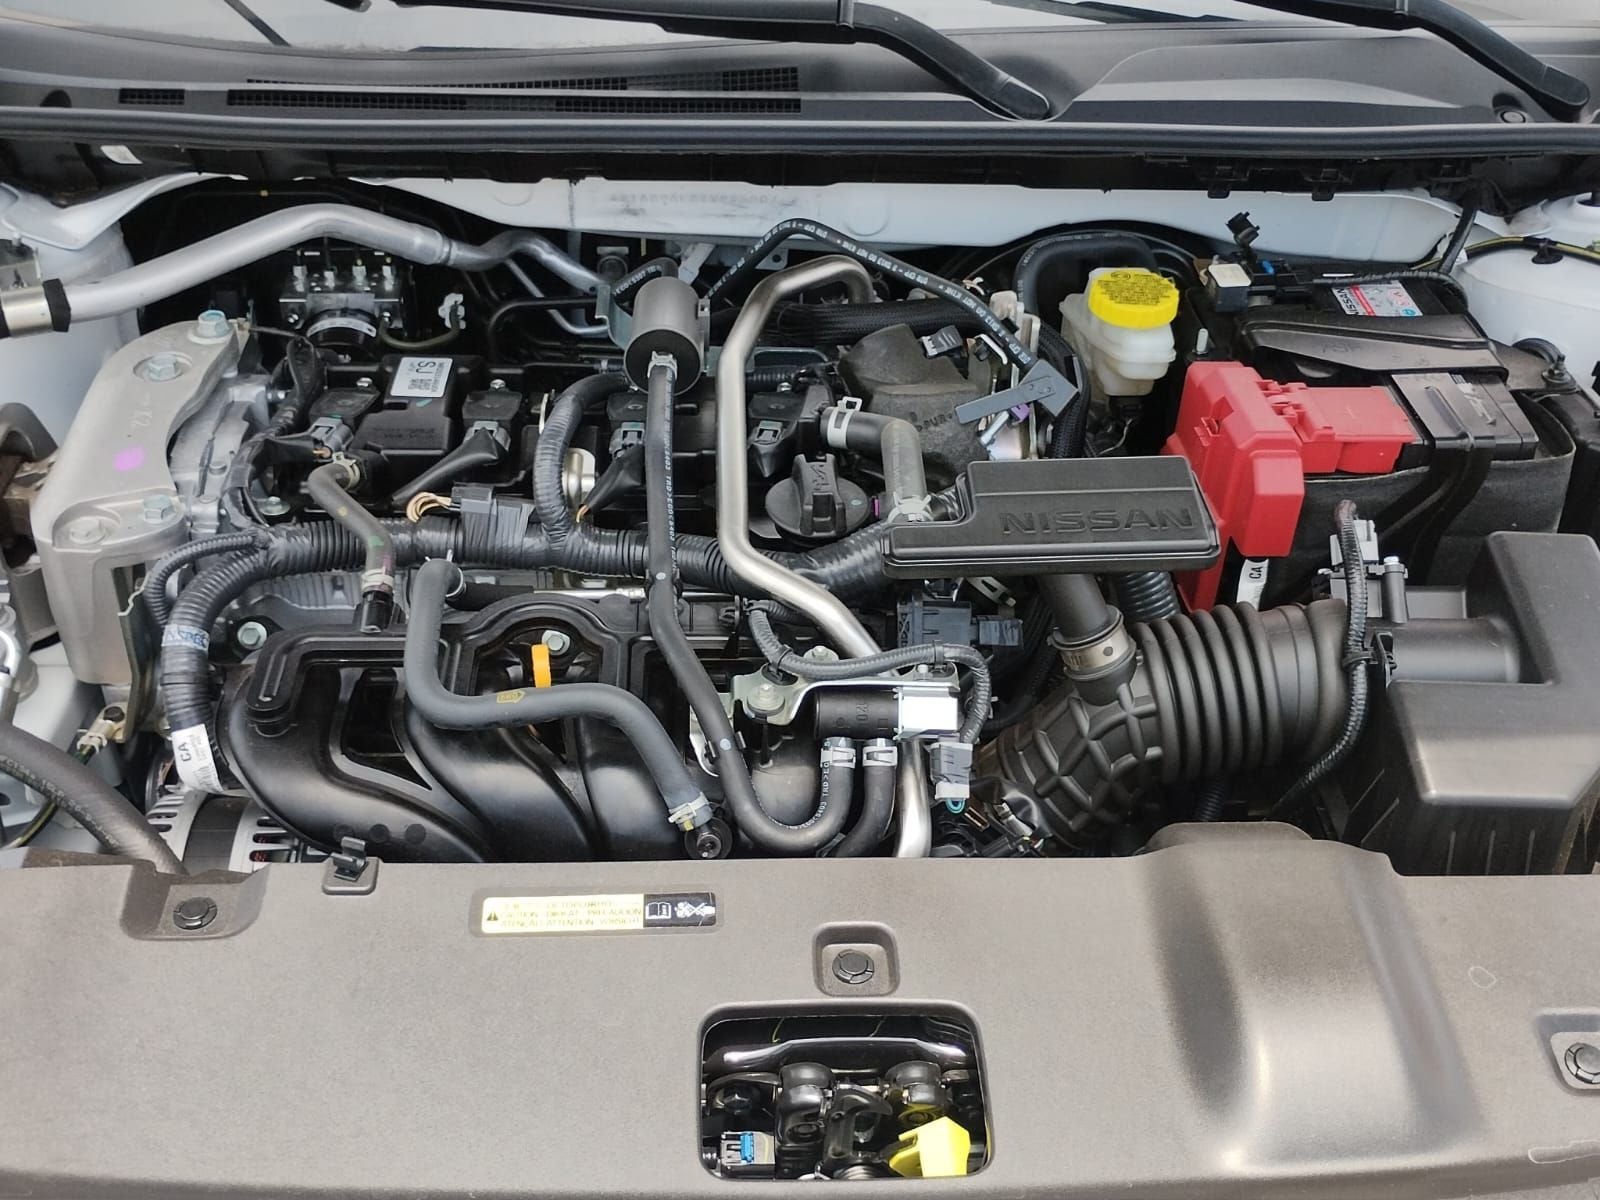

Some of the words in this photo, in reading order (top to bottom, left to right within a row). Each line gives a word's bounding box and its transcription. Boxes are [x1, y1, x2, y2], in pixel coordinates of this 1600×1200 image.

[1337, 287, 1360, 315] ISSAN
[1001, 507, 1194, 535] NISSAN
[1249, 566, 1262, 579] CA
[180, 741, 192, 762] CA
